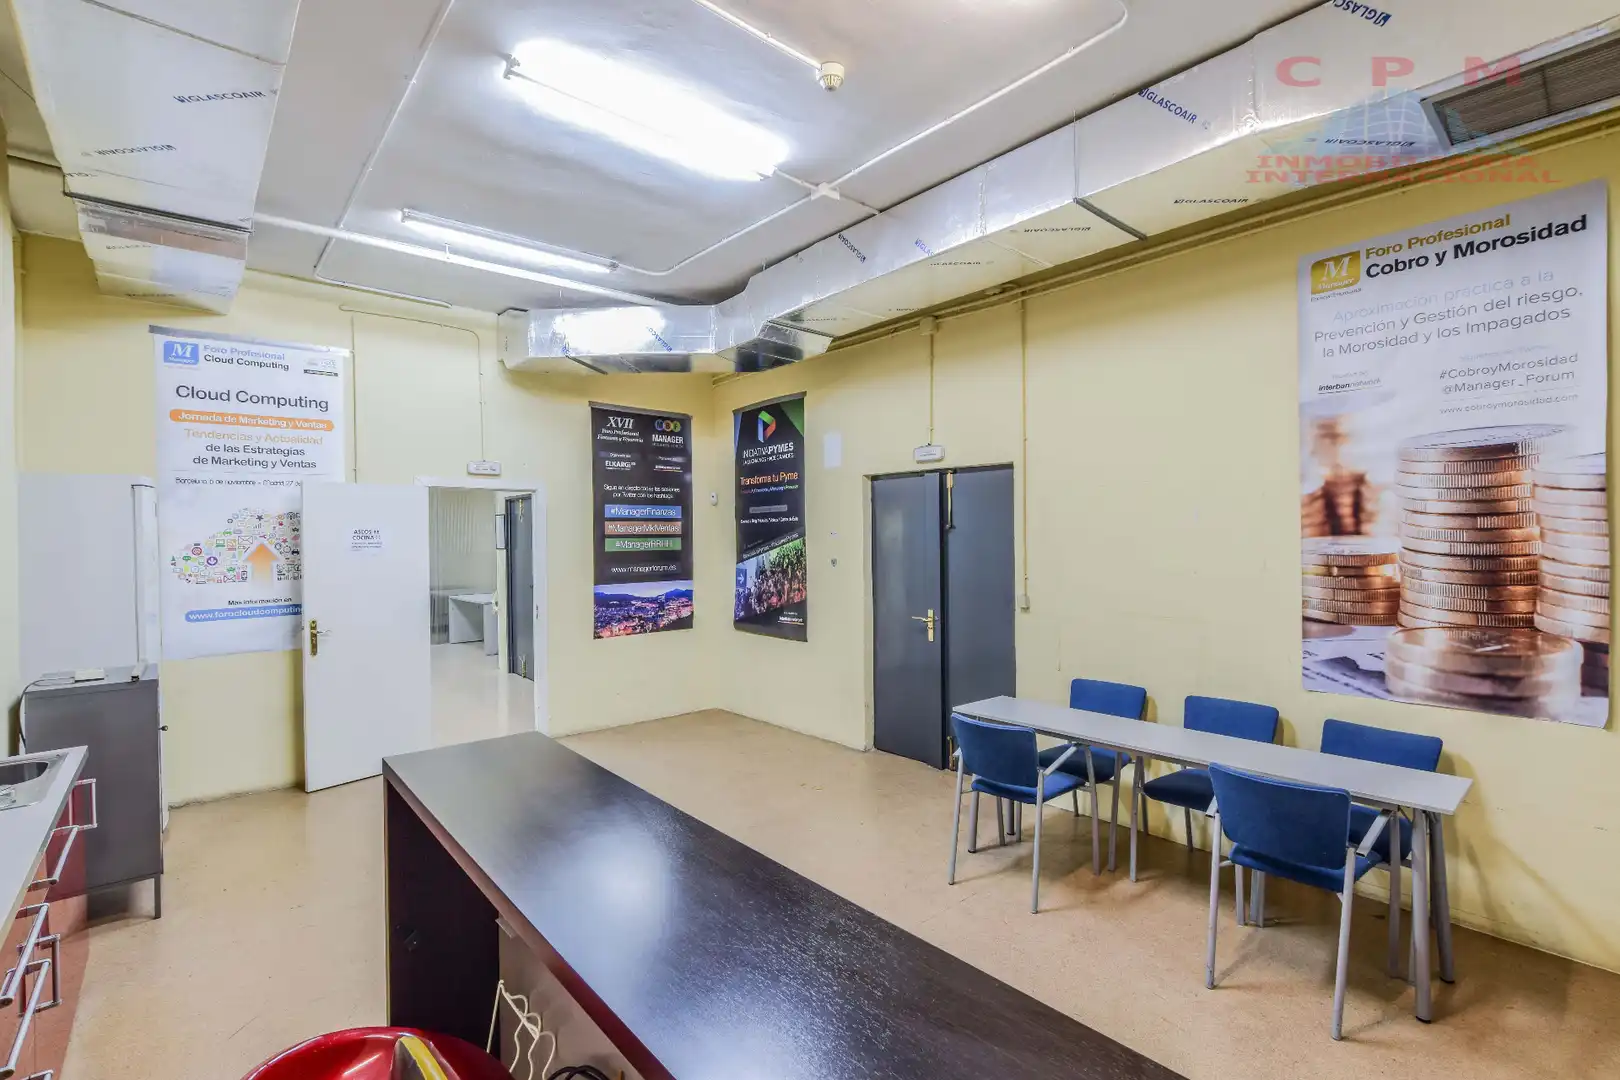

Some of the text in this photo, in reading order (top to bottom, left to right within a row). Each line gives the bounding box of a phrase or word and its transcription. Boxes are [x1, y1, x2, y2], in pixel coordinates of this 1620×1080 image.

[1332, 0, 1378, 20] GLASC
[1144, 90, 1198, 124] GLASCOAIR
[1365, 214, 1512, 260] Foro Profesional
[1365, 214, 1588, 279] Cobro y Morosidad
[1520, 275, 1531, 287] a
[1537, 269, 1554, 282] la
[1314, 319, 1397, 343] Prevención
[1400, 316, 1410, 331] y
[1413, 301, 1478, 324] Gestión
[1483, 295, 1511, 313] del
[1322, 307, 1571, 358] la Morosidad y los Impagados
[172, 343, 193, 358] M
[203, 344, 285, 361] Foro Profesional
[203, 354, 290, 372] Cloud Computing
[1439, 352, 1579, 381] #CobroyMorosidad
[175, 385, 329, 412] Cloud Computing
[1439, 393, 1579, 416] www.cobroymorosidad.com
[178, 411, 222, 422] Jornada
[224, 414, 237, 423] de
[239, 415, 287, 428] Marketing
[295, 420, 327, 429] Ventas
[606, 416, 635, 429] XVII
[184, 428, 323, 445] Tendencias y Actualidad
[651, 434, 684, 444] MANAGER
[205, 443, 305, 457] de las Estrategias
[192, 455, 317, 469] de Marketing y Ventas
[740, 471, 799, 486] Transforma tu Pyme
